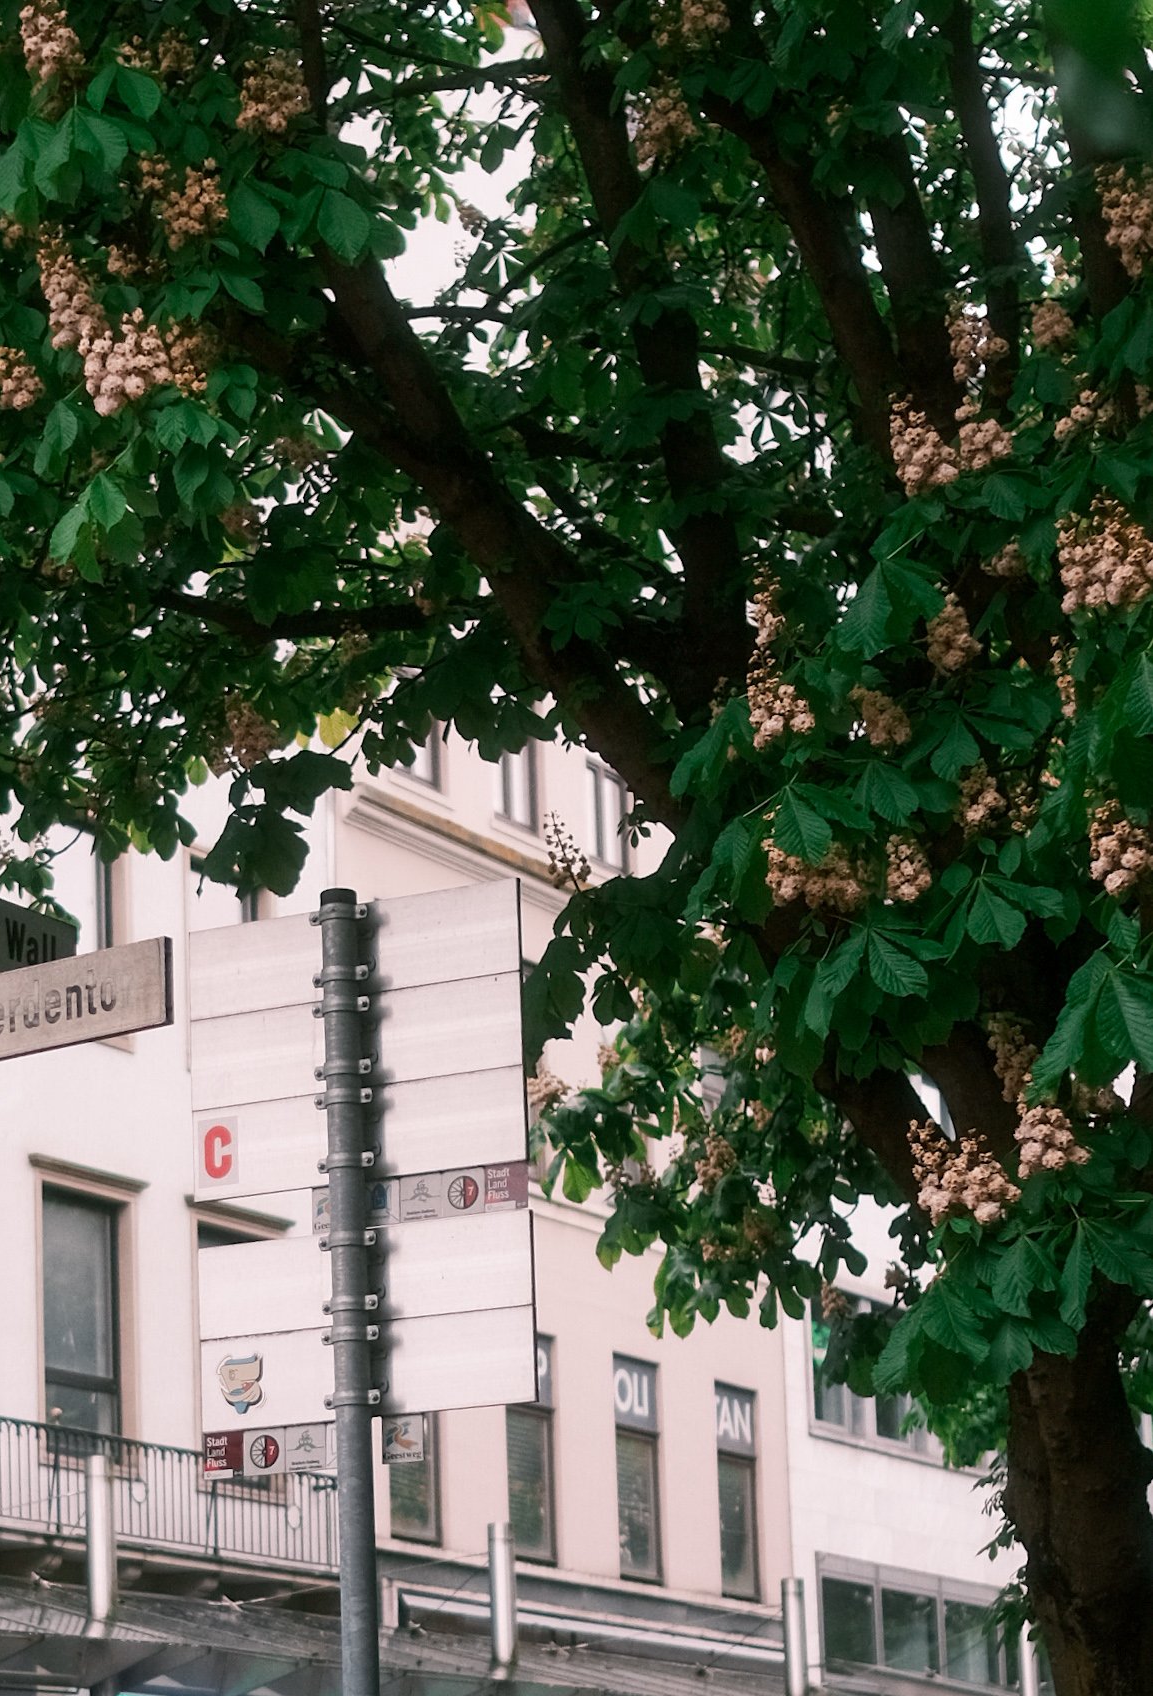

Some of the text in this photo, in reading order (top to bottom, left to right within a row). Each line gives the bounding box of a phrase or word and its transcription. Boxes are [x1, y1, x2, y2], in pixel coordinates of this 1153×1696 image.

[6, 917, 56, 965] Wall
[204, 1125, 232, 1179] C
[487, 1168, 510, 1179] Stadt
[487, 1179, 507, 1190] Land
[467, 1186, 475, 1197] 7
[487, 1189, 509, 1200] Fluss
[207, 1436, 228, 1447] Stadt
[207, 1447, 226, 1457] Land
[268, 1445, 276, 1455] 7
[383, 1450, 422, 1461] Geestweg
[207, 1458, 227, 1468] Fluss
